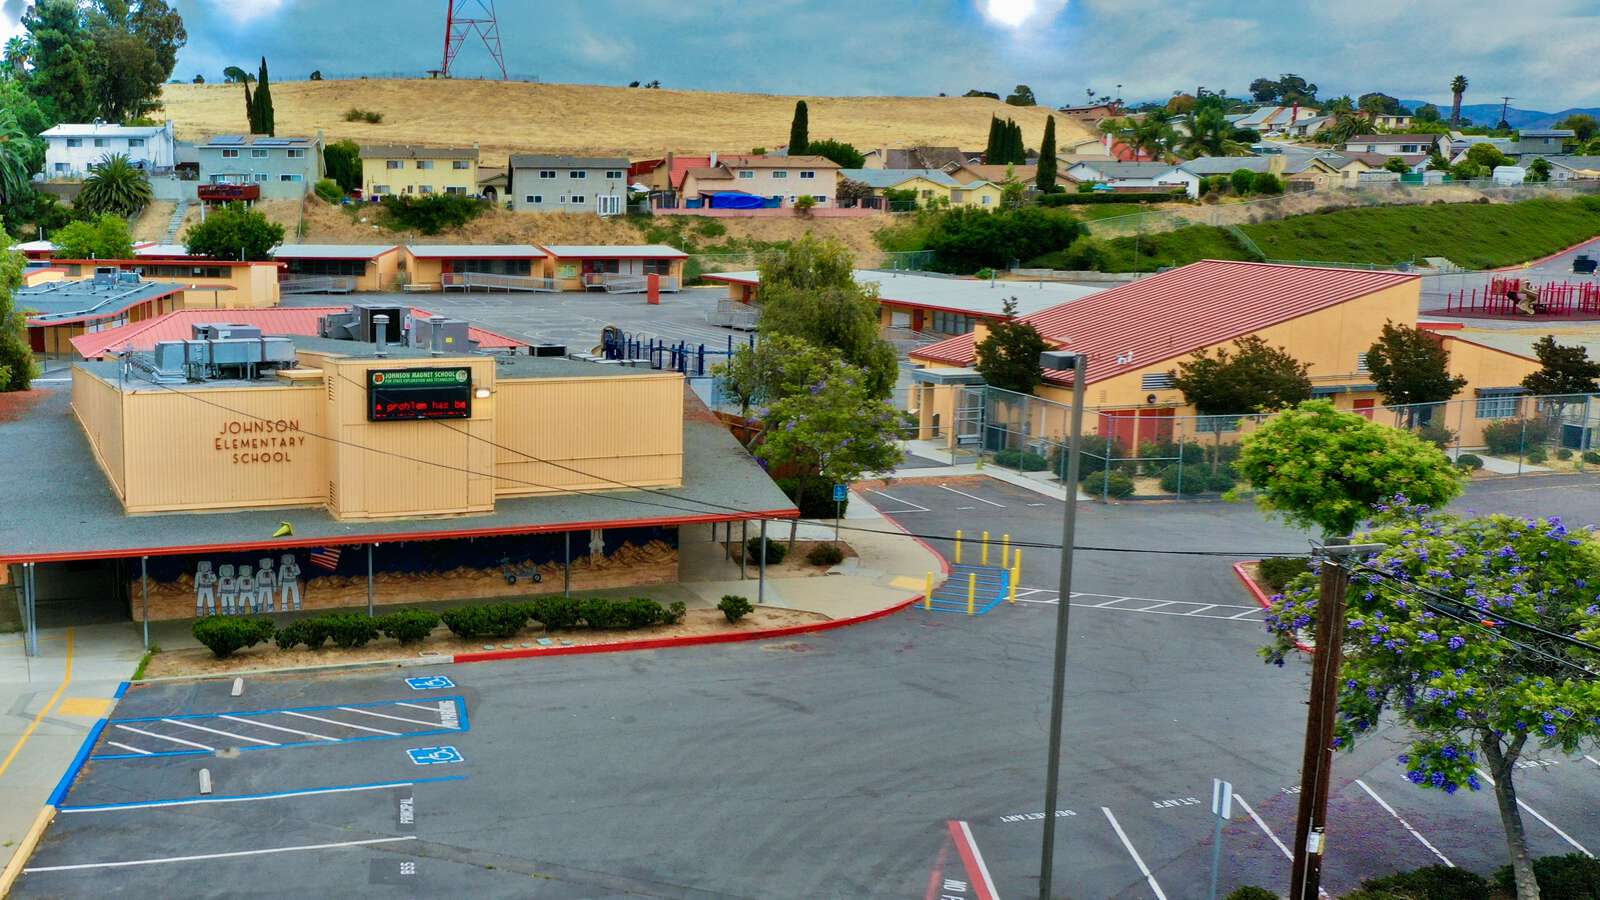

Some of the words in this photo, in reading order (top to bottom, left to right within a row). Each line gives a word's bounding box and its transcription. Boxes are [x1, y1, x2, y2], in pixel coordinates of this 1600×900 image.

[432, 401, 449, 409] has
[219, 420, 299, 435] JOHNSON
[215, 436, 304, 450] ELEMENTARY
[232, 452, 291, 464] SCHOOL
[944, 879, 967, 892] NO
